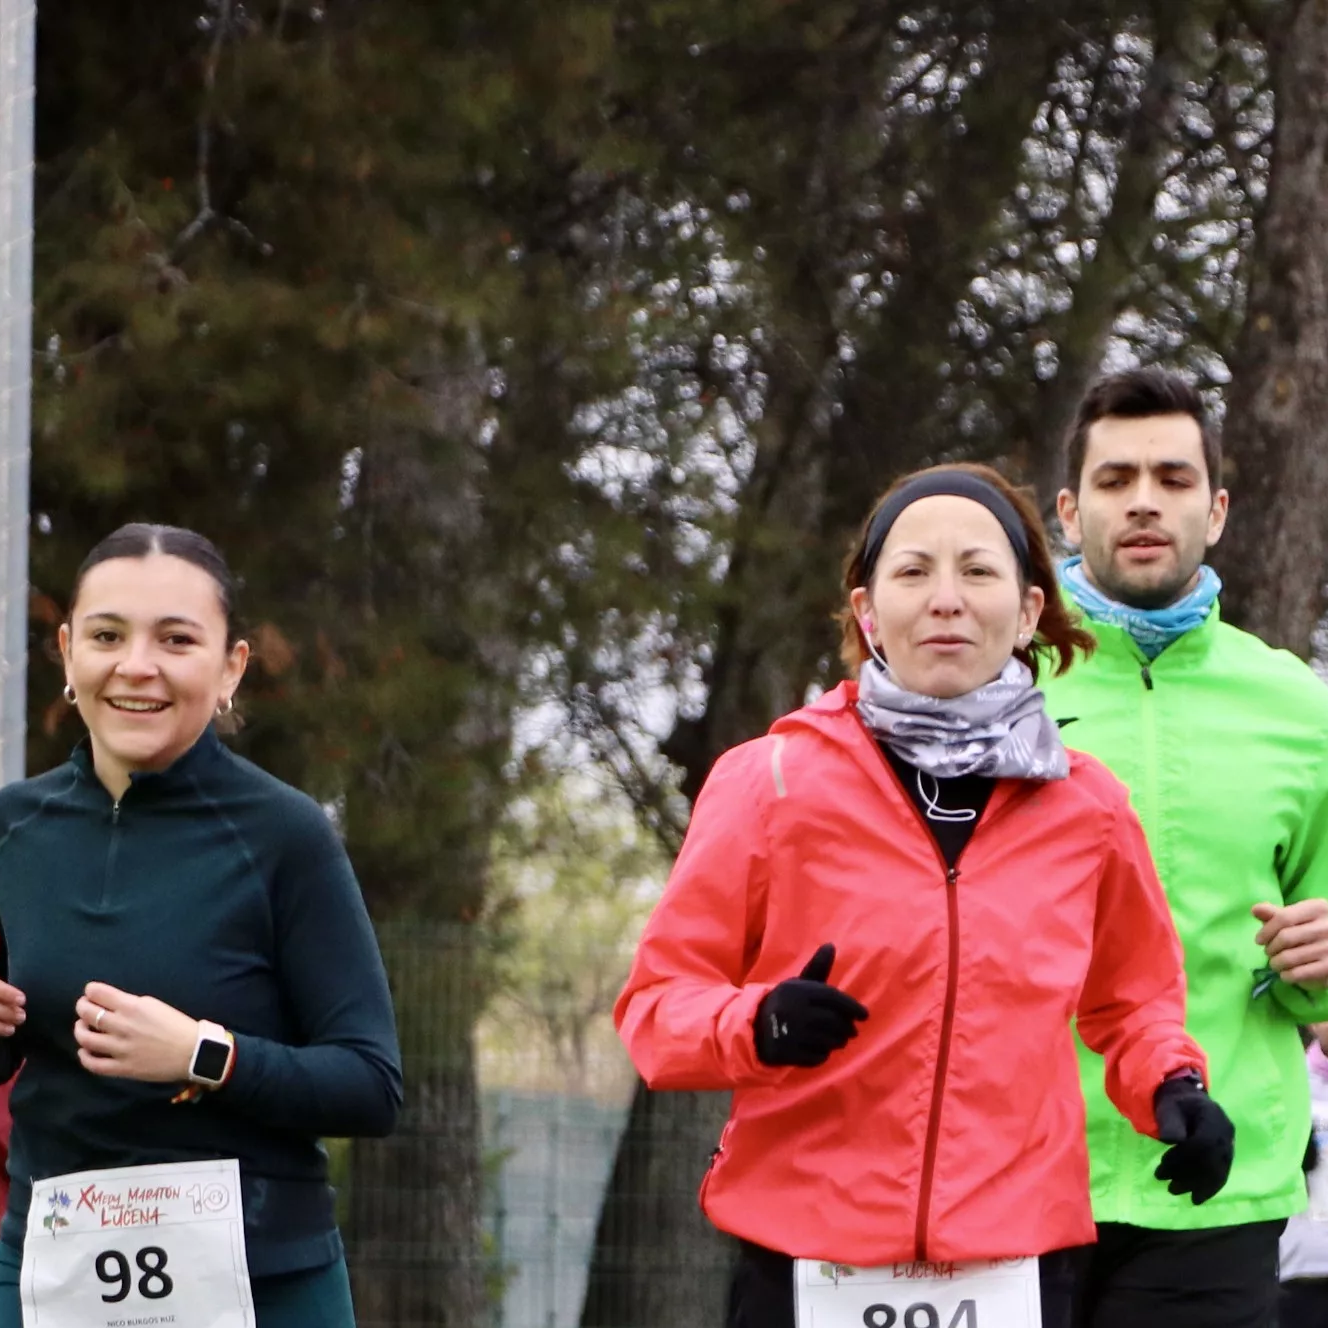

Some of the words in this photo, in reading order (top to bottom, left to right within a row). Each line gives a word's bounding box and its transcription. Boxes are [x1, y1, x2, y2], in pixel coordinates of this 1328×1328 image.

[100, 1206, 168, 1228] LUCENA
[94, 1245, 174, 1304] 98
[892, 1261, 964, 1280] LUCENA
